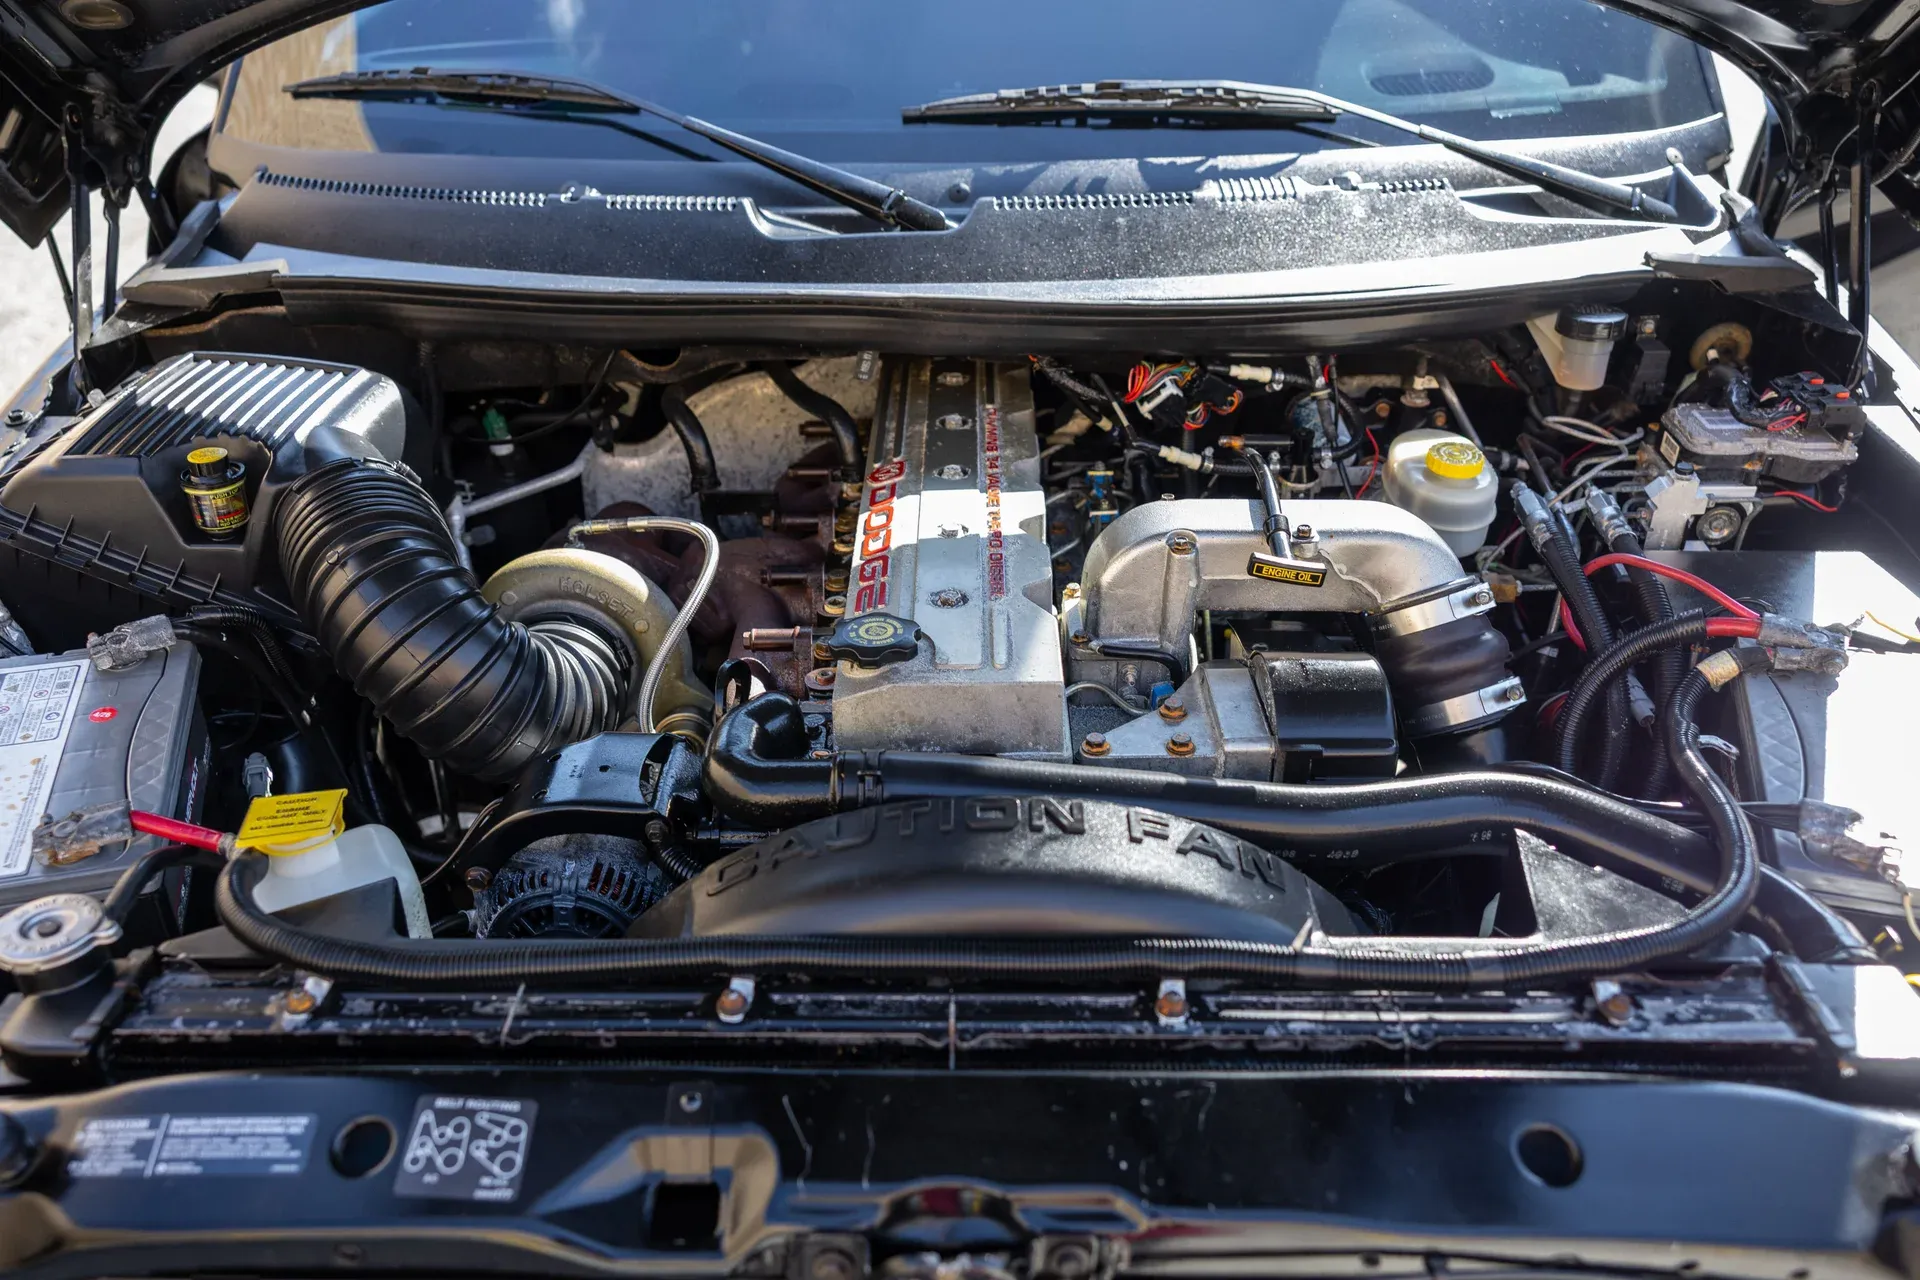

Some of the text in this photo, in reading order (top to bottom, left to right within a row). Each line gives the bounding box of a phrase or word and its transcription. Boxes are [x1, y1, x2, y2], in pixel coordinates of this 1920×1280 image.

[986, 472, 1001, 508] VALVE
[854, 482, 897, 615] DODGE
[1262, 565, 1313, 582] ENGINE OIL
[558, 576, 635, 618] HOLSET
[275, 806, 311, 814] ENGINE
[276, 797, 318, 805] CAUTION
[697, 794, 1286, 897] CAUTION FAN
